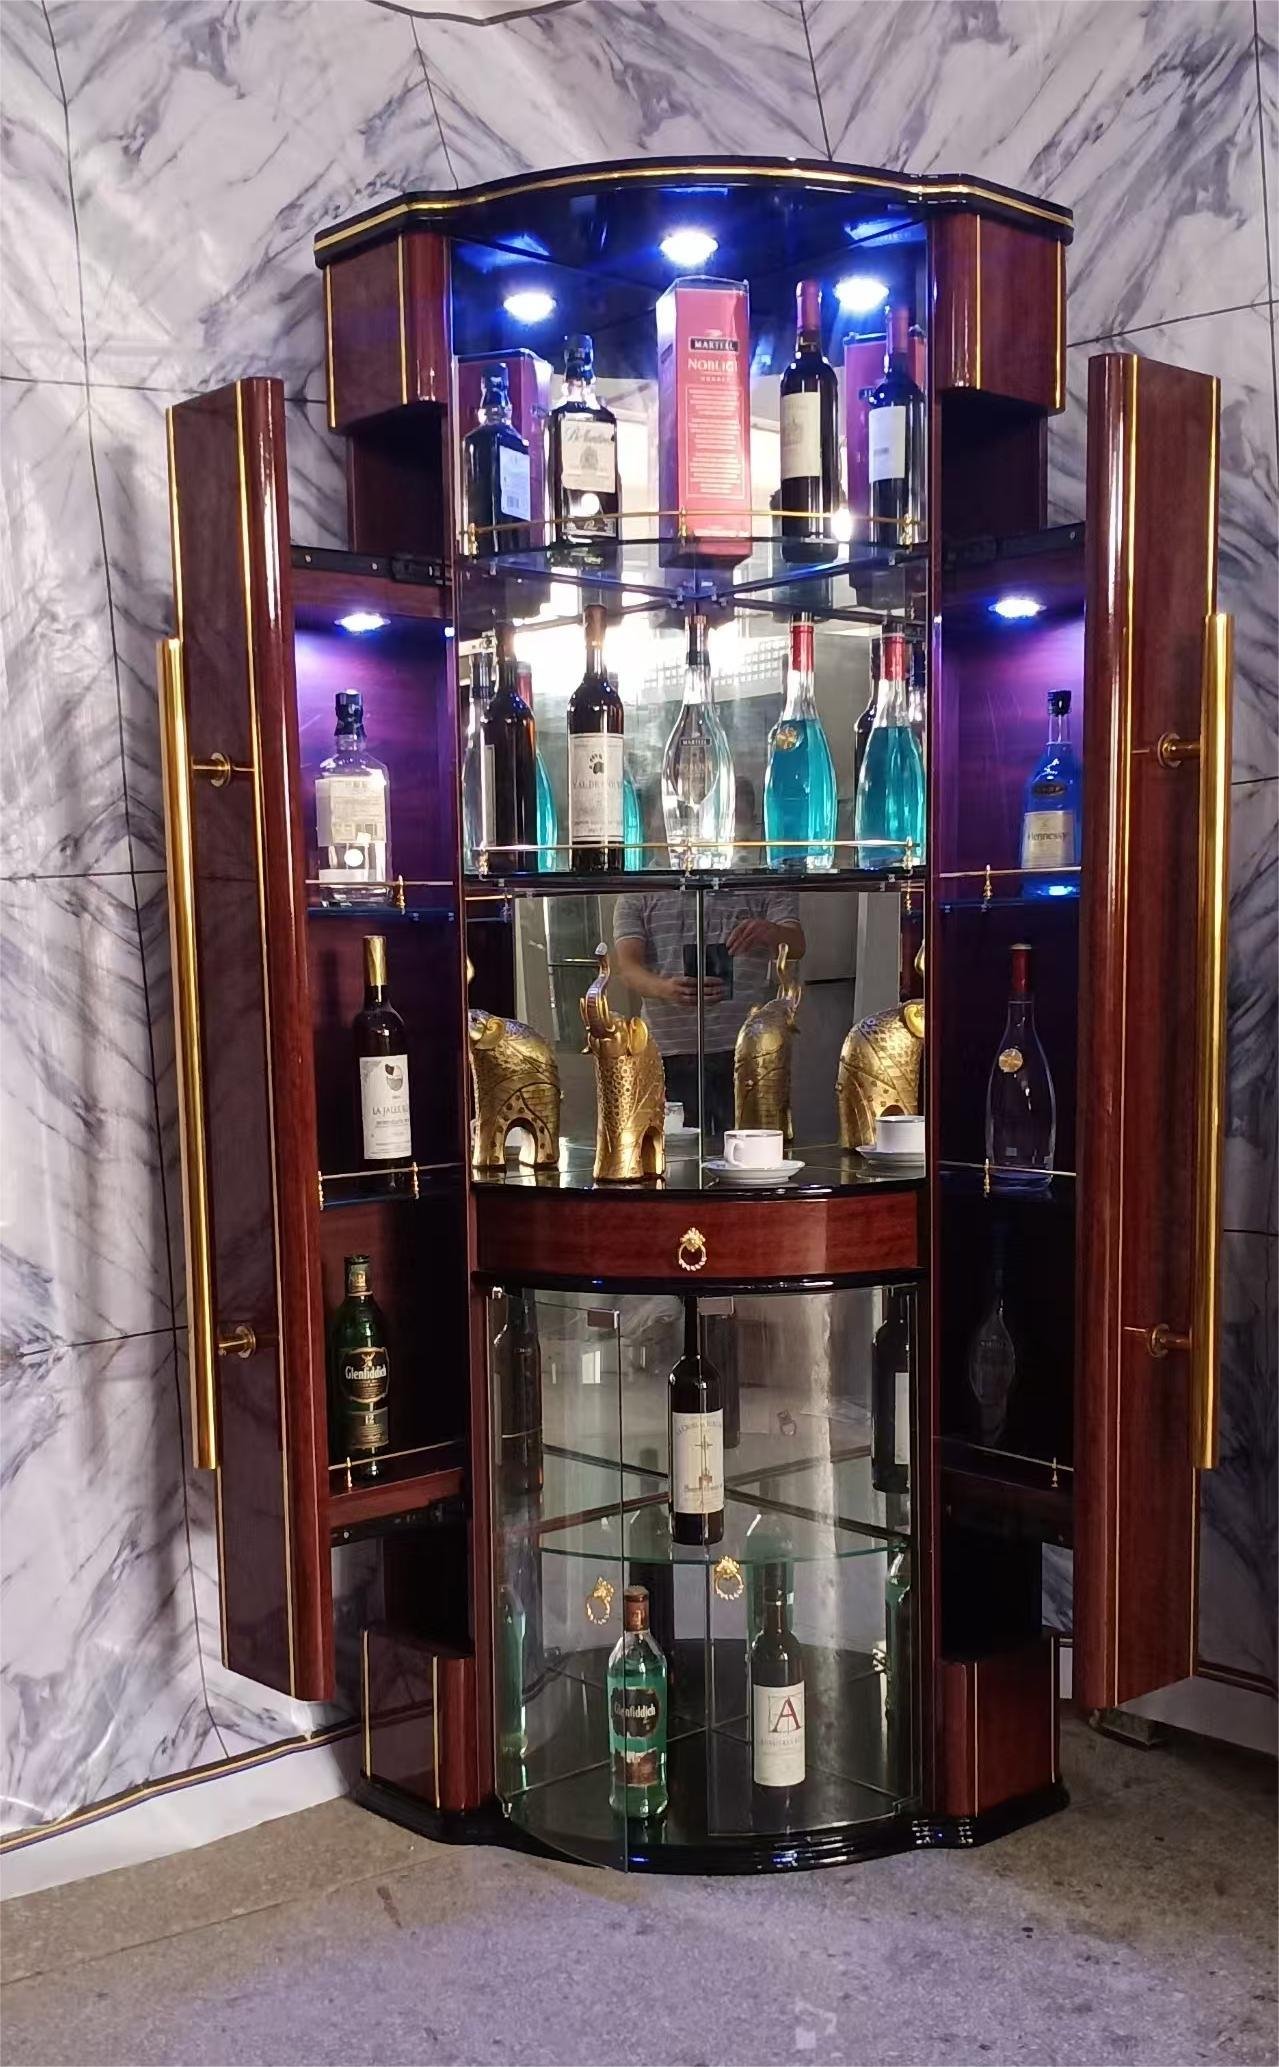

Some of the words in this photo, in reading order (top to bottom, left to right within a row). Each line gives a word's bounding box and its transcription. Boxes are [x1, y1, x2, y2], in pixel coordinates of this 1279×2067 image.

[694, 340, 735, 351] MARTELL
[345, 1363, 387, 1380] Glenfiddich
[365, 1414, 375, 1425] 12
[771, 1696, 801, 1733] A
